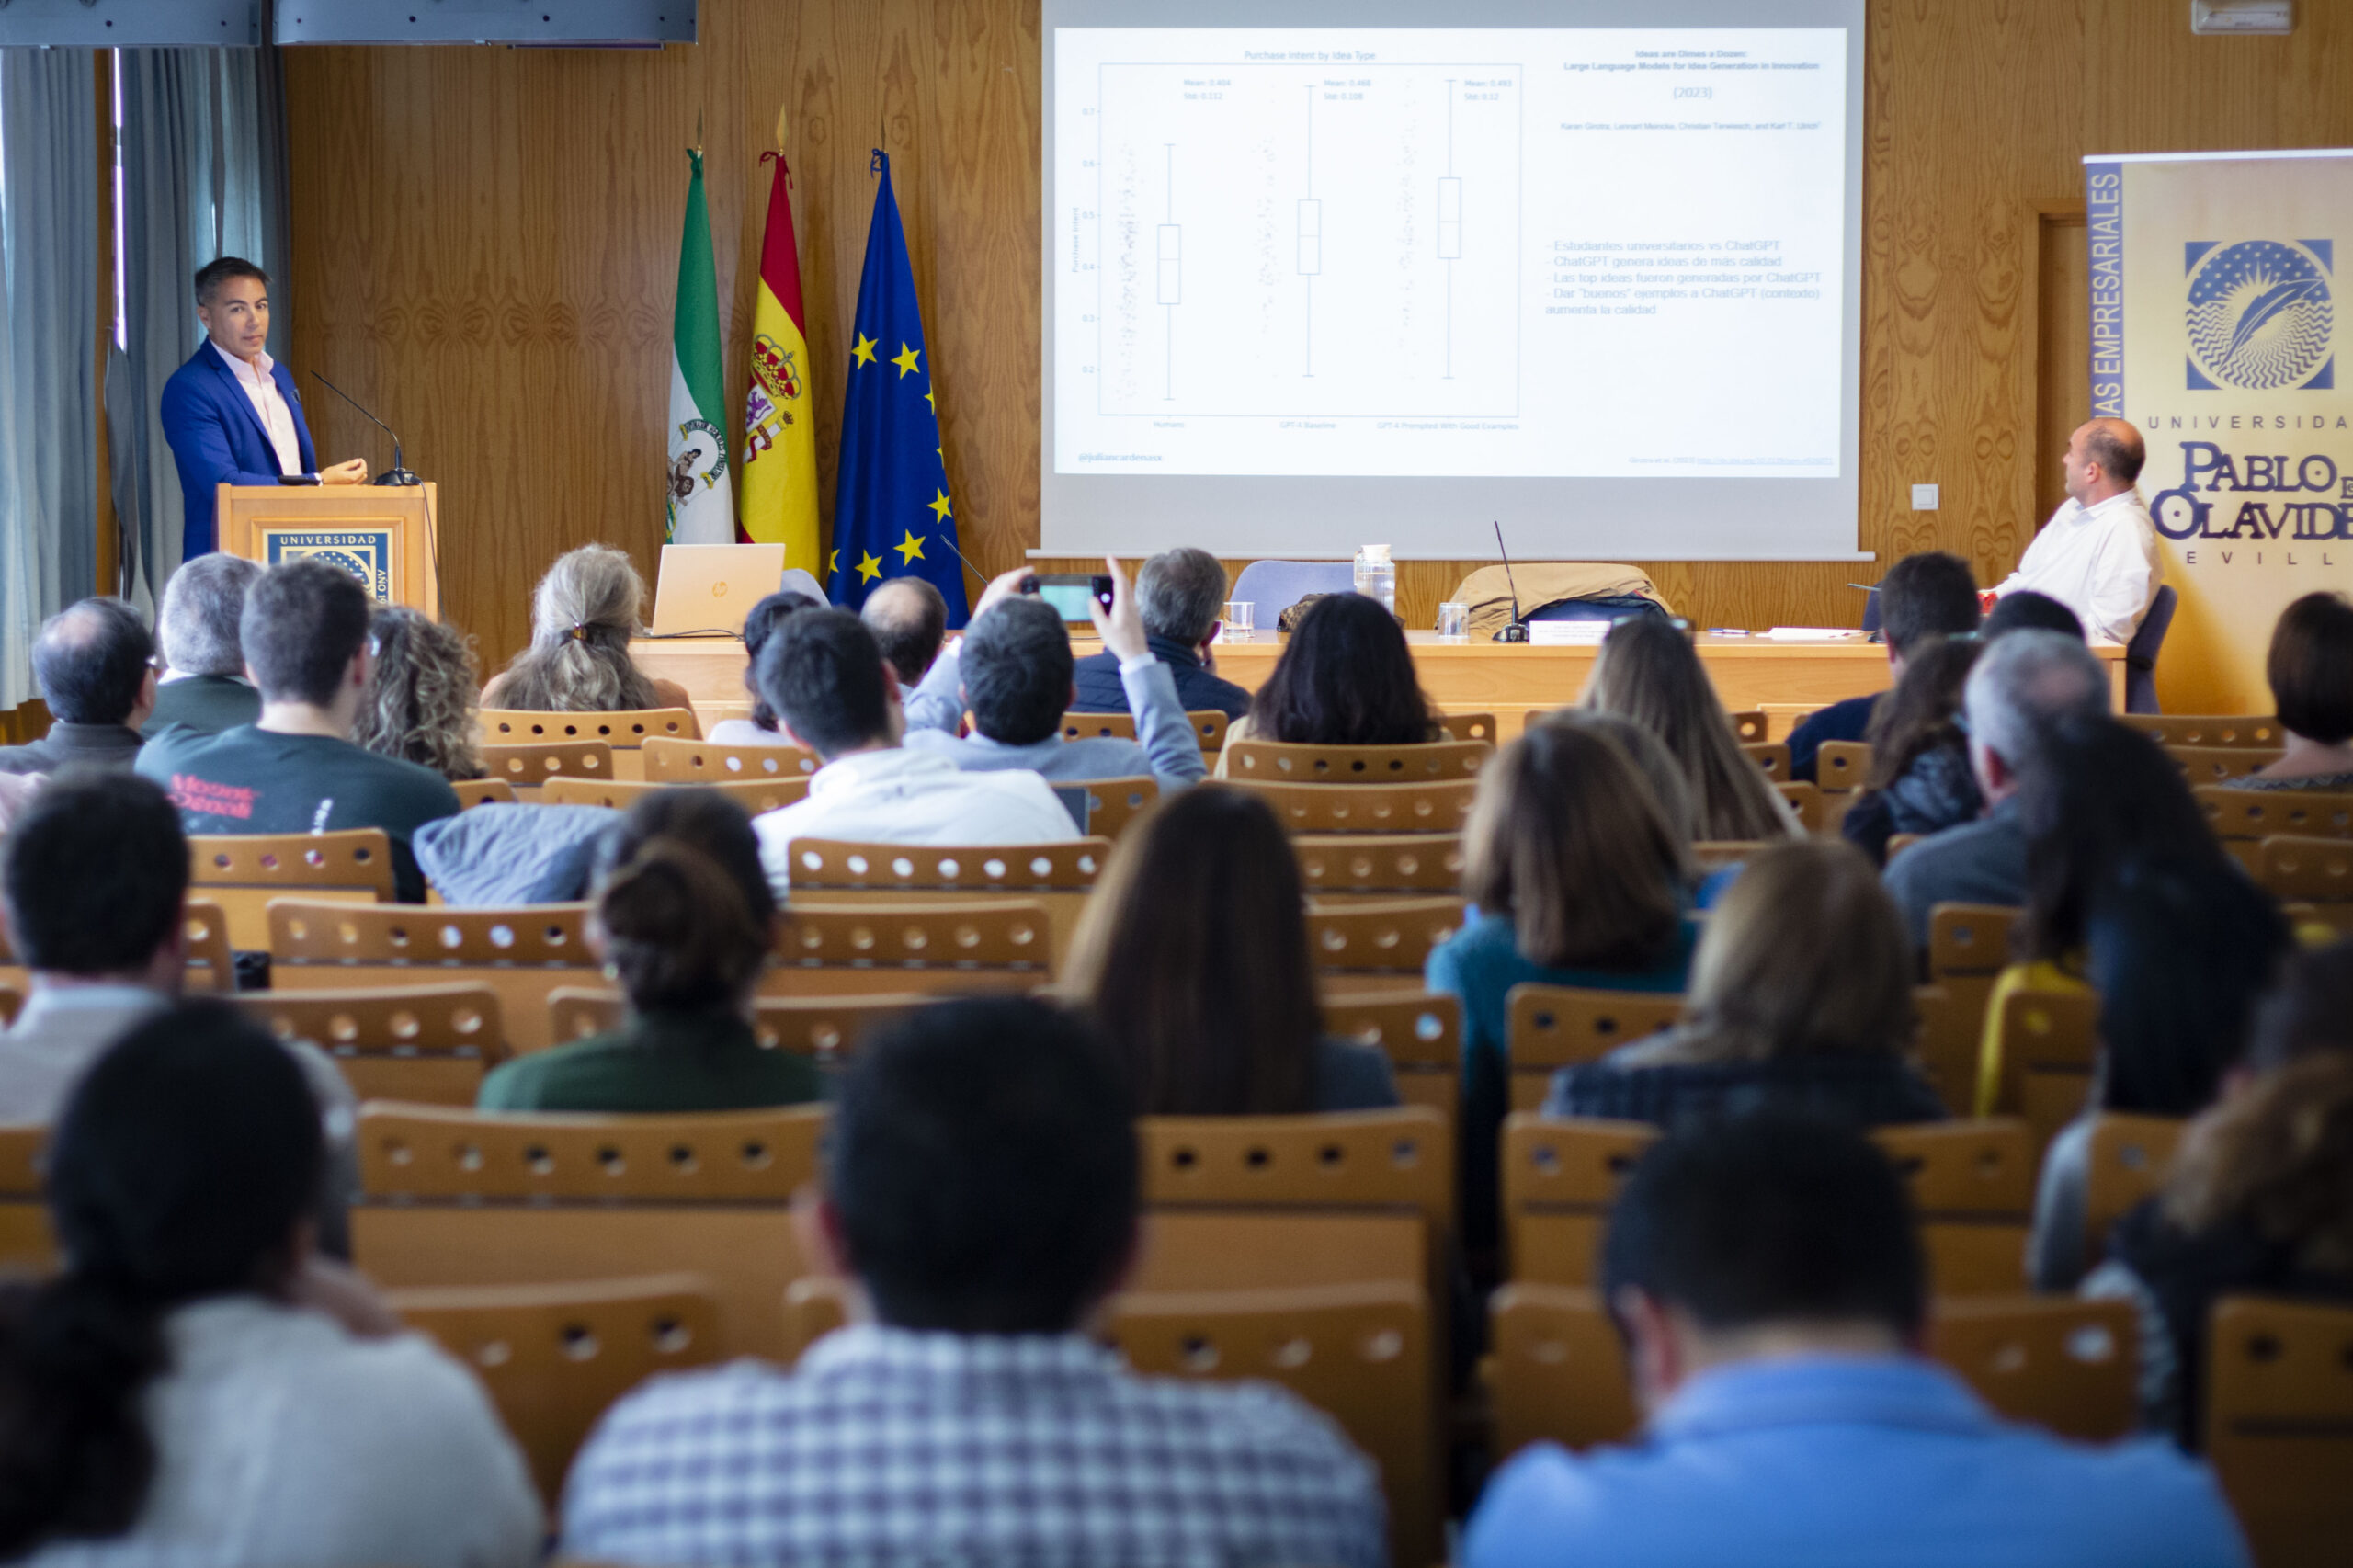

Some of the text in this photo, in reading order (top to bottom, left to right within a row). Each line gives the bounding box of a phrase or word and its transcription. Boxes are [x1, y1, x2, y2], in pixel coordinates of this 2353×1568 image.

[1244, 51, 1376, 62] Purchase Intent by Idea Type
[1635, 50, 1659, 58] Ideas
[1563, 62, 1820, 72] Large Language Models for Idea Generation in Innovation
[1673, 86, 1713, 99] (2023)
[1553, 240, 1780, 251] Estudiantes universitarios vs ChatGPT
[1553, 256, 1609, 267] ChatGPT
[1612, 257, 1654, 269] genera
[1656, 256, 1689, 267] ideas
[1691, 256, 1708, 267] de
[1738, 256, 1783, 267] calidad
[1553, 272, 1822, 285] Las top ideas fueron generadas por ChatGPT
[2092, 173, 2121, 374] EMPRESARIALES
[1553, 288, 1574, 299] Dar
[1633, 288, 1688, 301] ejemplos
[1690, 290, 1699, 299] a
[1701, 287, 1757, 299] ChatGPT
[1759, 288, 1821, 301] (contexto)
[1545, 304, 1657, 315] aumenta la calidad
[2148, 415, 2347, 430] UNIVERSIDA
[2178, 441, 2338, 493] PABLO
[2149, 488, 2353, 540] OLAVIDE
[279, 535, 377, 546] UNIVERSIDAD
[2186, 551, 2334, 566] EVILL
[377, 568, 388, 593] AÑO
